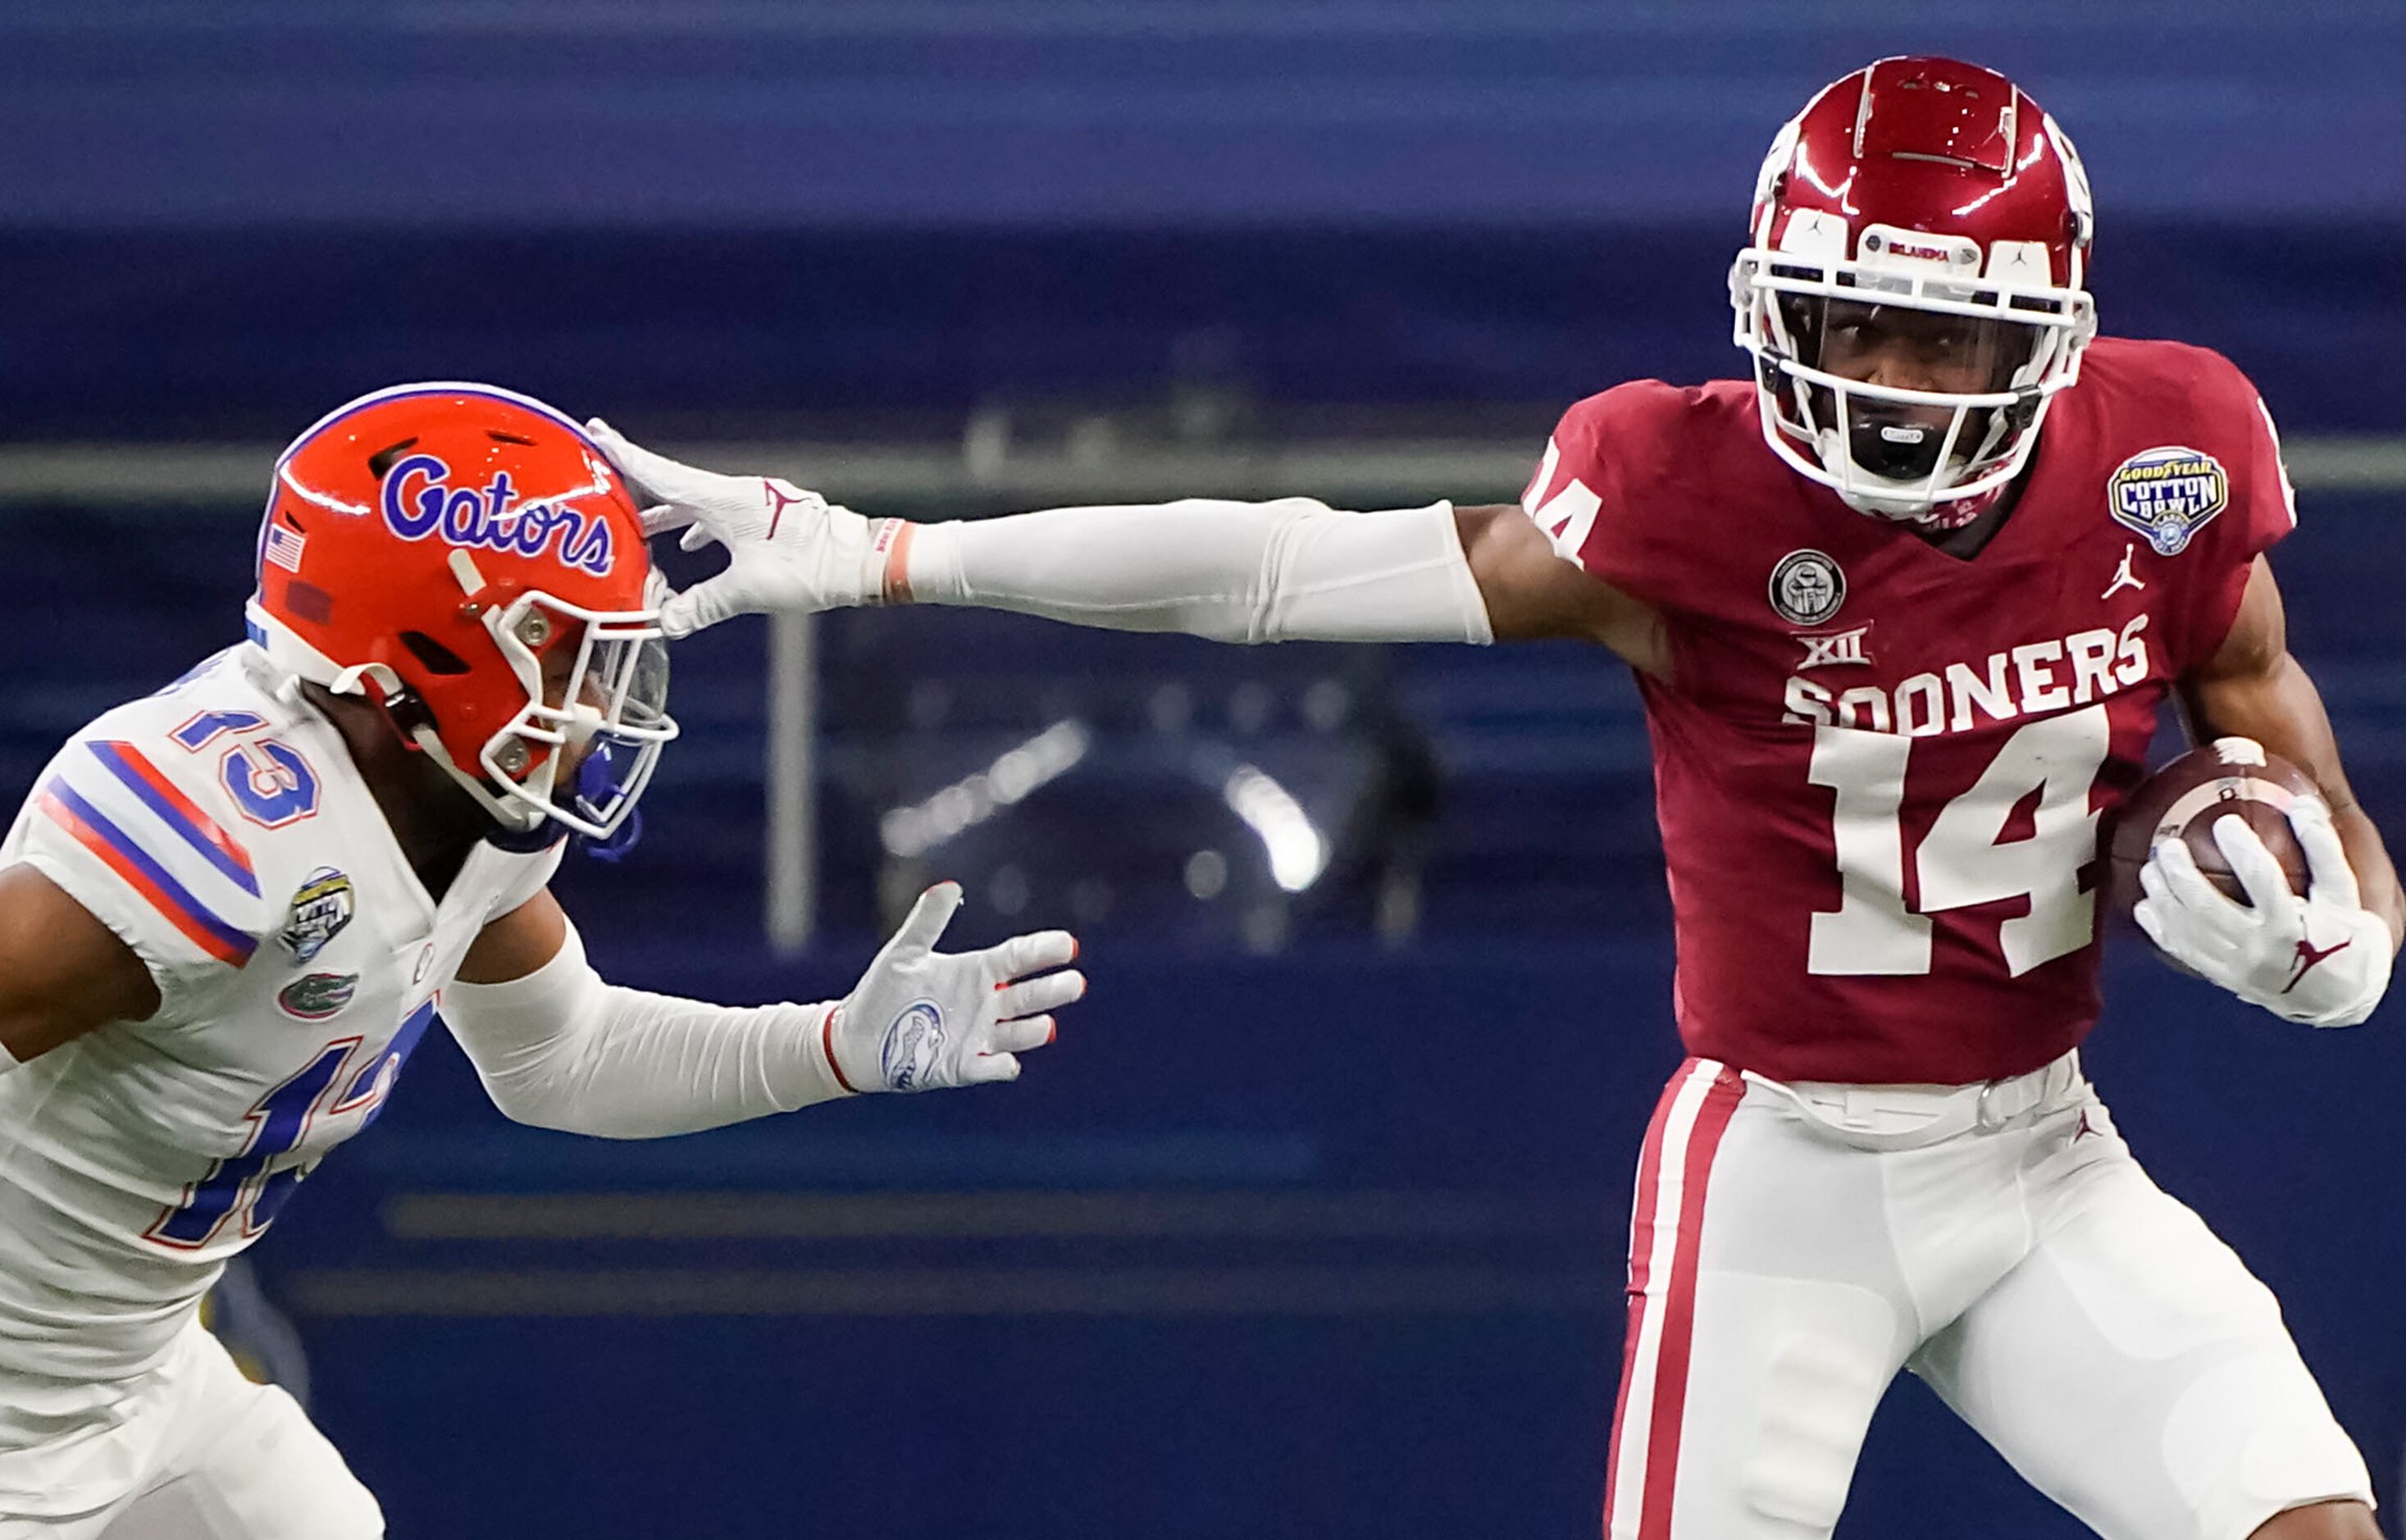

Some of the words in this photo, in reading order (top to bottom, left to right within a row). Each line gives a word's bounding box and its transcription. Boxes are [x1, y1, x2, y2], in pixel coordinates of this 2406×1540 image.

[2119, 461, 2212, 481] GOODYEAR
[382, 453, 616, 578] Gators
[2120, 475, 2217, 514] COTTON
[2139, 496, 2201, 520] BOWL
[1796, 626, 1873, 672] XII
[1781, 613, 2149, 737] SOONERS
[1807, 703, 2106, 979] 14
